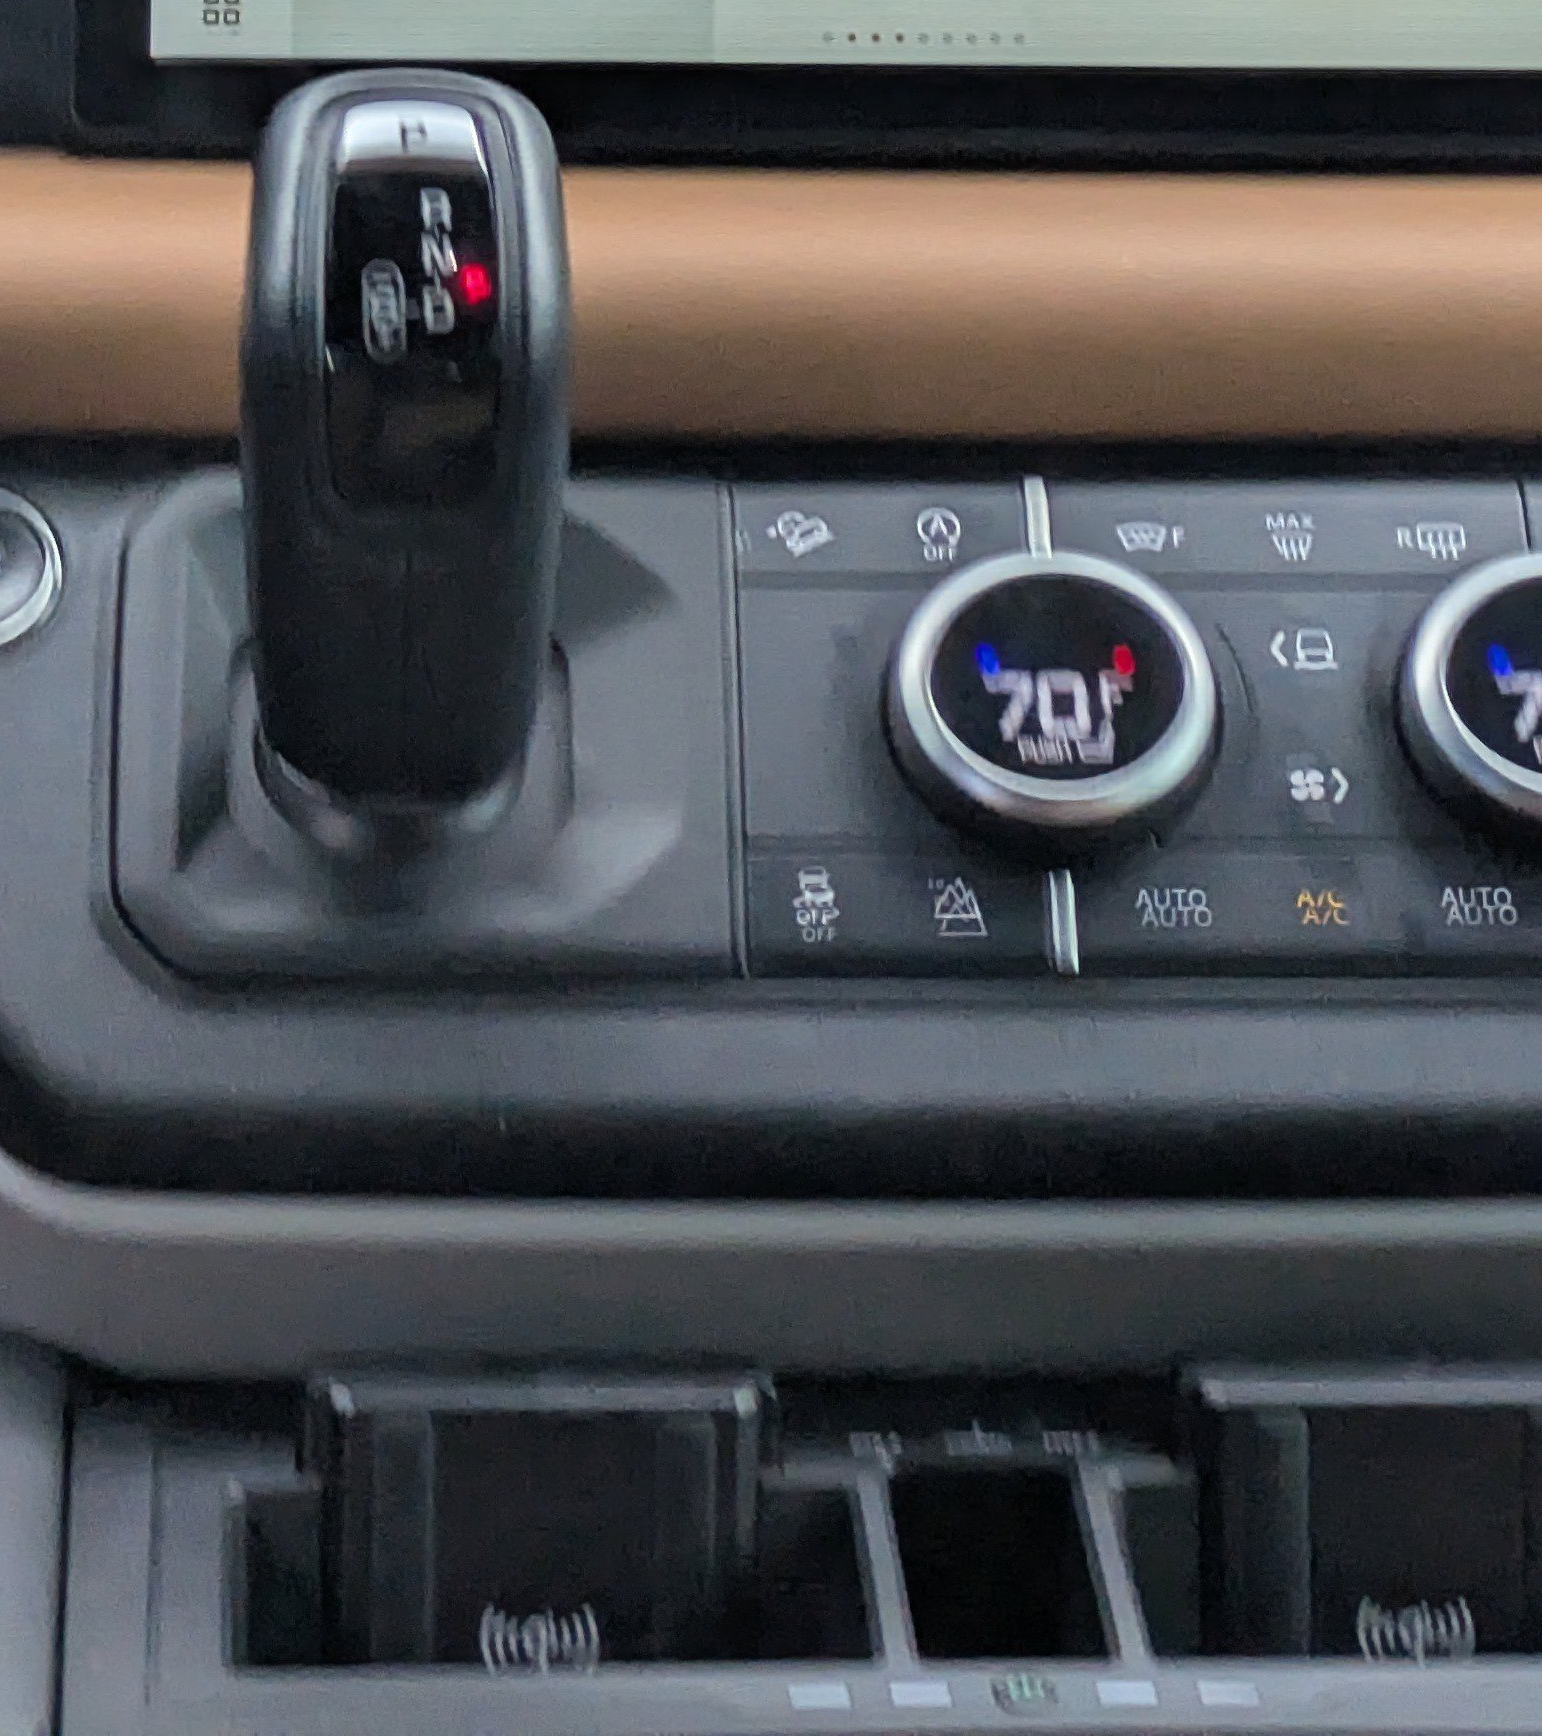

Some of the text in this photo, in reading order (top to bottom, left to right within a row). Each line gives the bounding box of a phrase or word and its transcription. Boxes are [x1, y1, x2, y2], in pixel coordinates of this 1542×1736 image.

[1265, 512, 1314, 531] MAX
[1134, 888, 1214, 928] AUTO
[1295, 888, 1351, 925] A/C
[1439, 886, 1519, 927] AUTO
